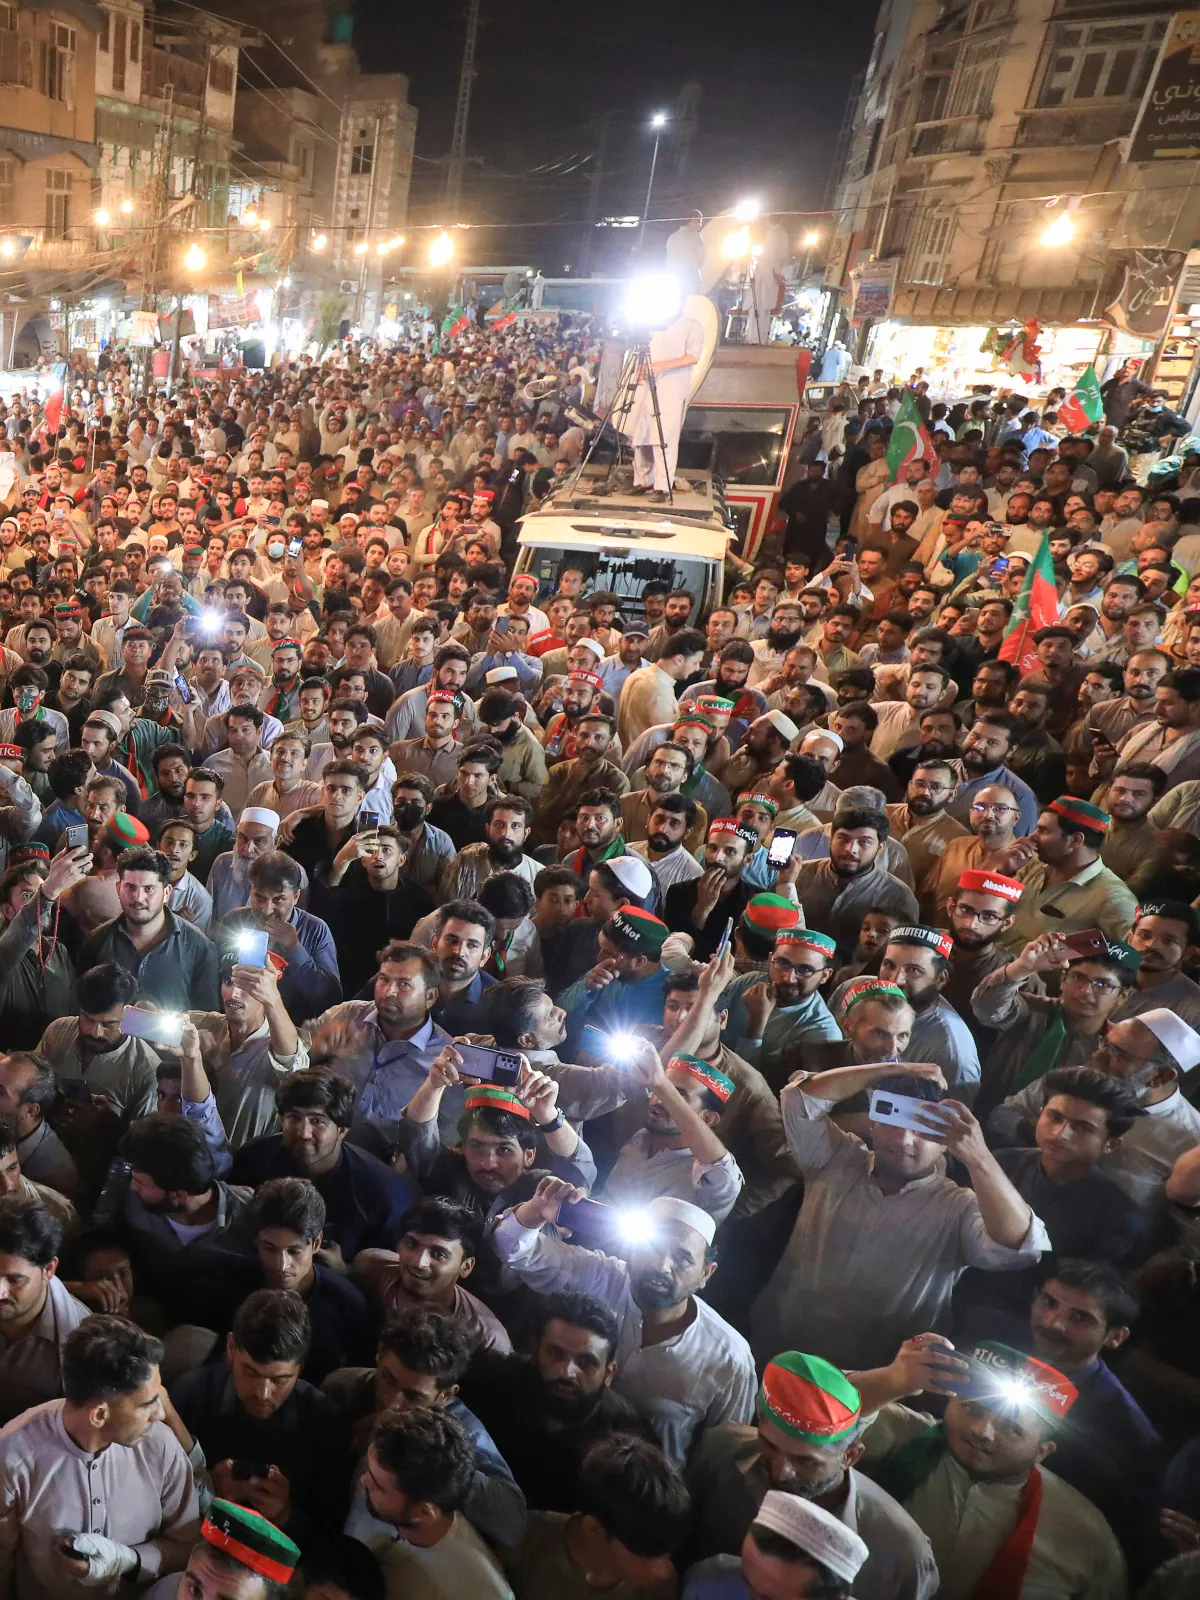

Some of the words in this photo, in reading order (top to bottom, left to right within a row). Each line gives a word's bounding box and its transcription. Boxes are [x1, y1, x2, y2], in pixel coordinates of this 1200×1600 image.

[586, 673, 599, 685] NOT
[752, 793, 764, 802] NOT
[725, 822, 737, 831] Not
[624, 924, 641, 941] Not
[926, 931, 943, 946] NOT
[845, 988, 857, 1005] NOT
